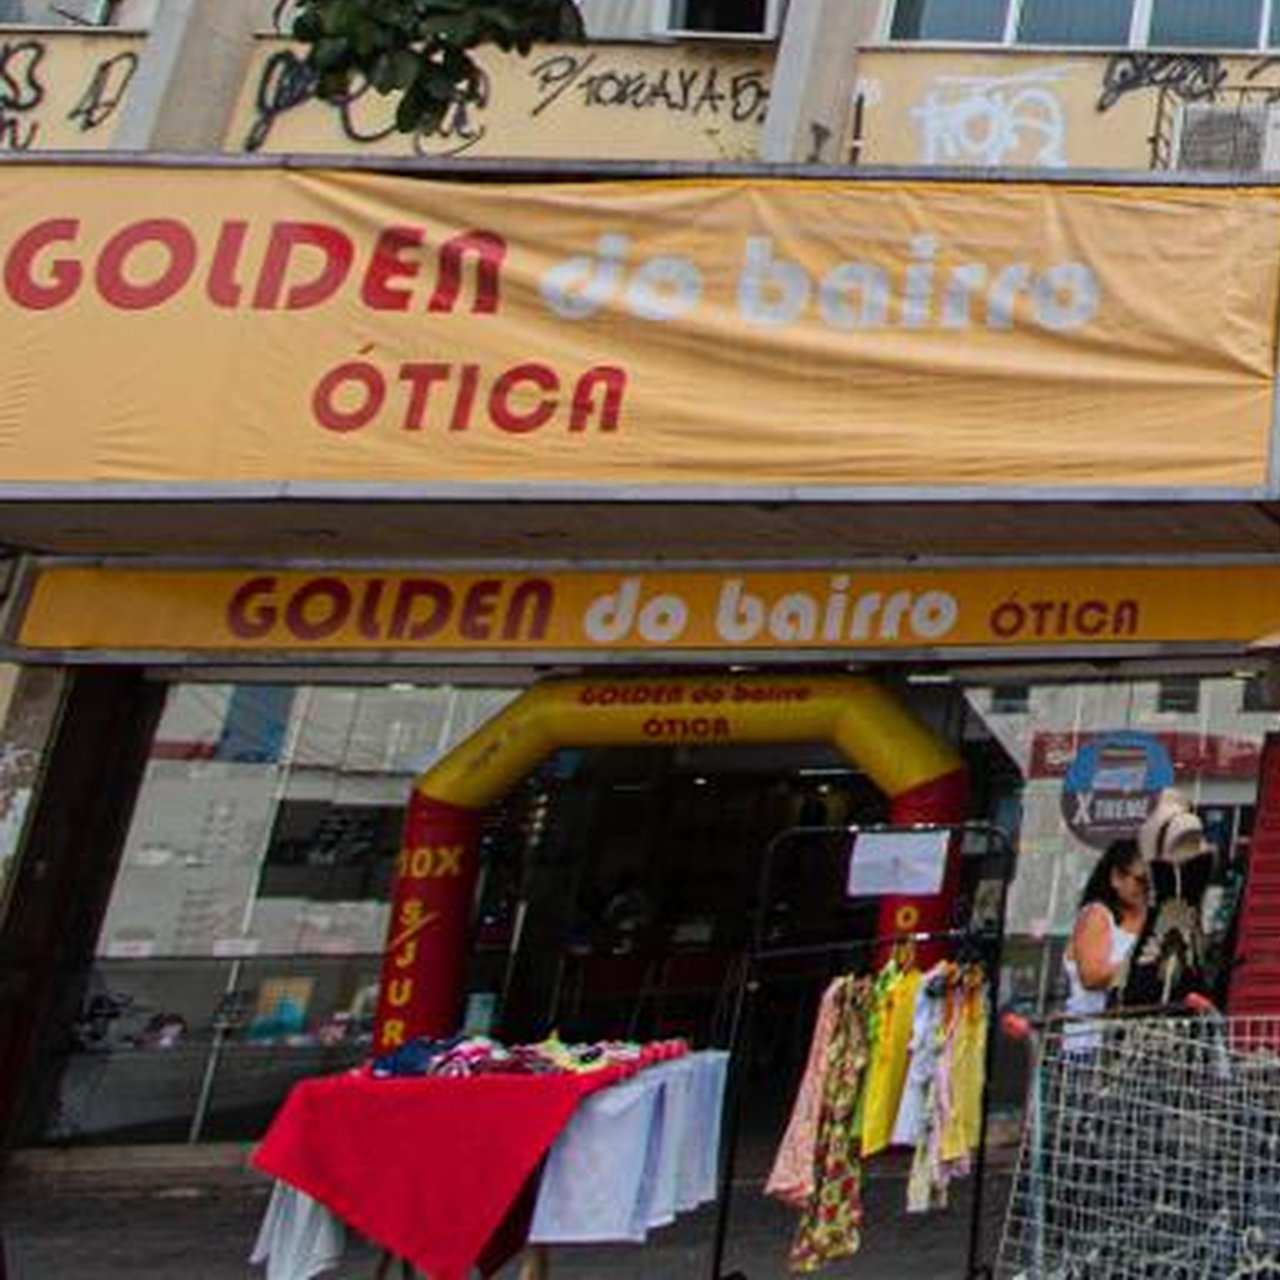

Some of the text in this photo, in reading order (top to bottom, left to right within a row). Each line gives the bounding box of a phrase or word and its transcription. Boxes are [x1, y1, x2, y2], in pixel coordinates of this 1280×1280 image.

[3, 218, 1099, 330] GOLDEN do bairro
[311, 343, 627, 434] ÓTICA
[226, 574, 1139, 643] GOLDEN do bairro ÓTICA
[580, 682, 685, 707] GOLDEN
